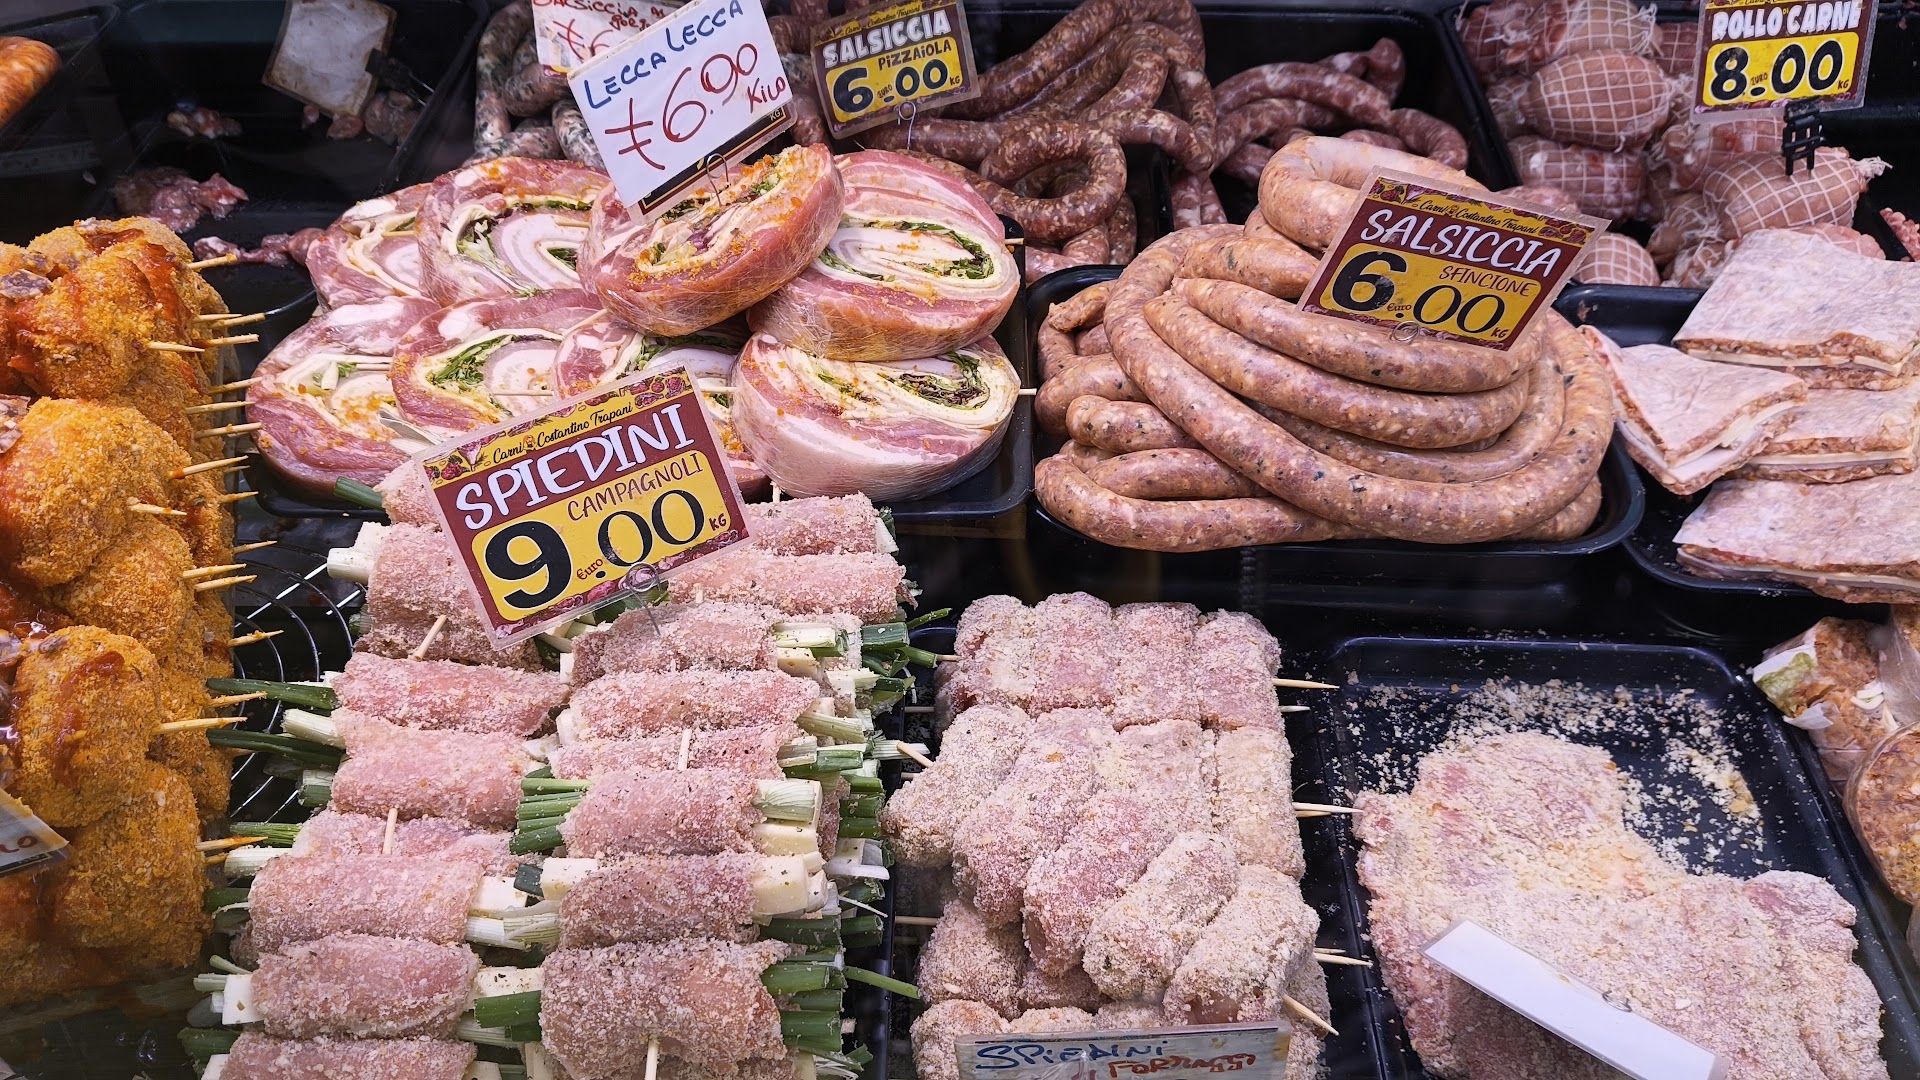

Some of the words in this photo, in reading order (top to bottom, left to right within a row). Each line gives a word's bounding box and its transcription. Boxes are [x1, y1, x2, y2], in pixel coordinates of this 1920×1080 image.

[822, 9, 951, 69] SALSICCIA
[1712, 7, 1783, 41] ROLLO
[1787, 1, 1861, 35] CARNE
[584, 52, 667, 109] LECCA
[666, 0, 743, 52] LECCA
[950, 75, 961, 86] KG
[1710, 39, 1843, 101] 8.00
[1837, 79, 1849, 90] KG
[833, 58, 948, 113] 6.00
[1360, 208, 1562, 278] SALSICCIA
[1420, 200, 1448, 214] Carni
[1456, 208, 1501, 226] Costantino
[1502, 218, 1540, 234] Trapani
[1332, 251, 1505, 334] 6.00
[1439, 265, 1538, 297] SFINCIONE
[1490, 327, 1509, 338] KG
[493, 442, 524, 464] Carni
[537, 420, 590, 448] Costantino
[590, 402, 633, 427] Trapani
[456, 403, 695, 531] SPIEDINI
[567, 452, 704, 522] CAMPAGNOLI
[484, 489, 705, 609] 9.00
[708, 512, 727, 532] KG
